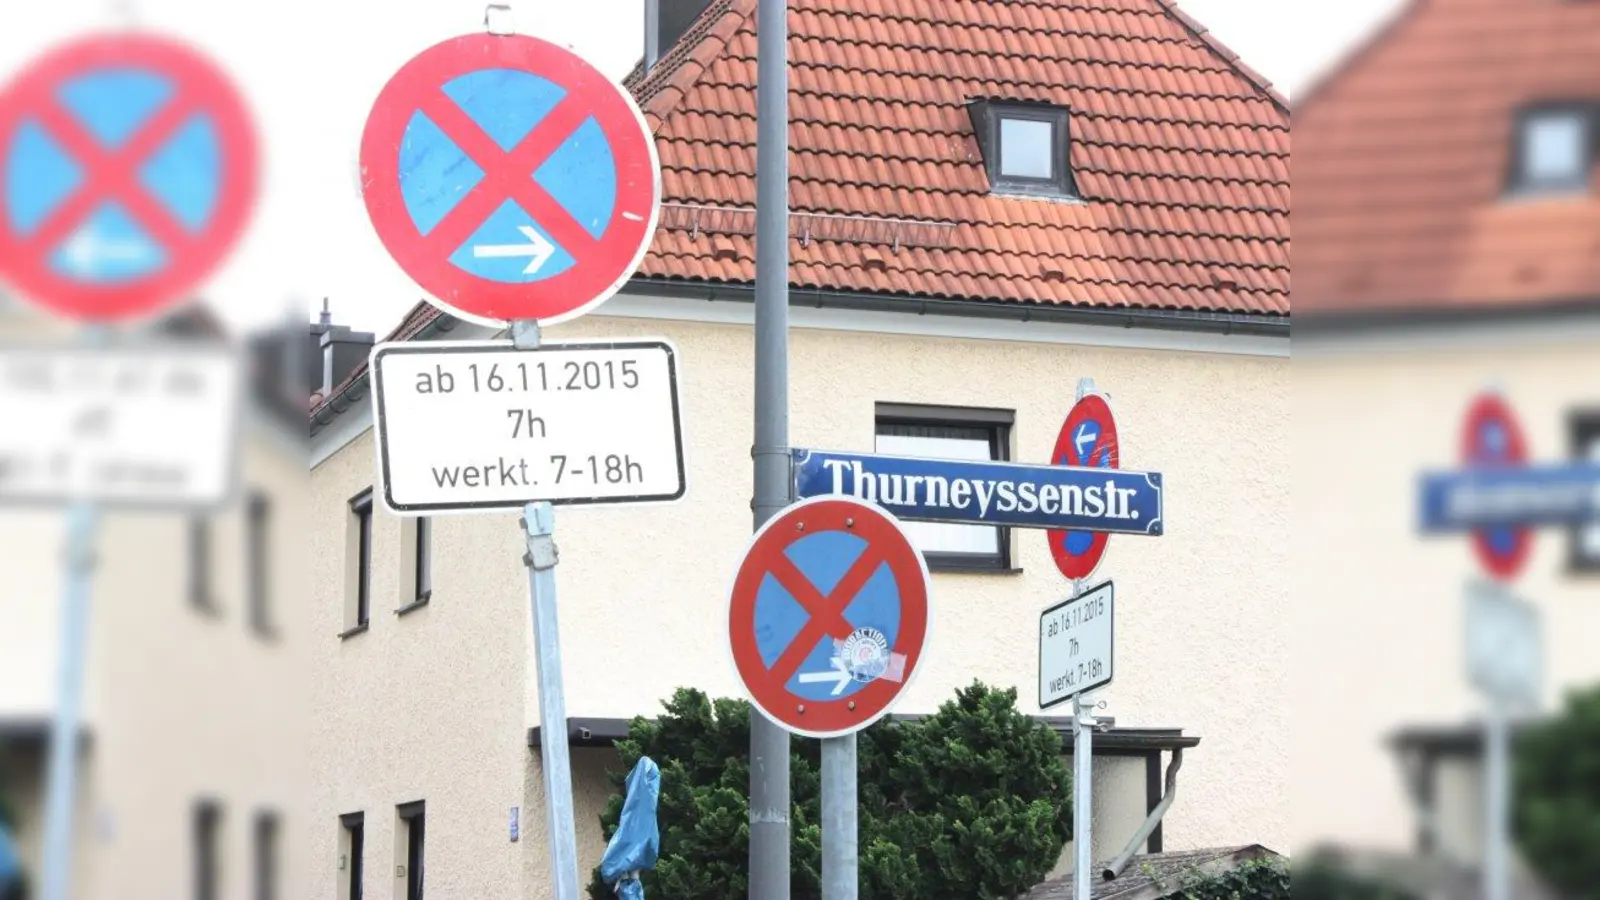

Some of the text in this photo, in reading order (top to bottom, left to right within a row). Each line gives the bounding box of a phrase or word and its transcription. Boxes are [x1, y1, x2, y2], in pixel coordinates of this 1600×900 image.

[415, 360, 639, 394] ab 16.11.2015
[507, 409, 546, 438] 7h
[431, 454, 643, 488] werkt. 7-18h
[823, 459, 1140, 520] Thurneyssenstr.
[1048, 596, 1104, 637] ab 16.11.2015
[1069, 638, 1079, 658] 7h
[1050, 659, 1103, 694] werkt. 7-18h
